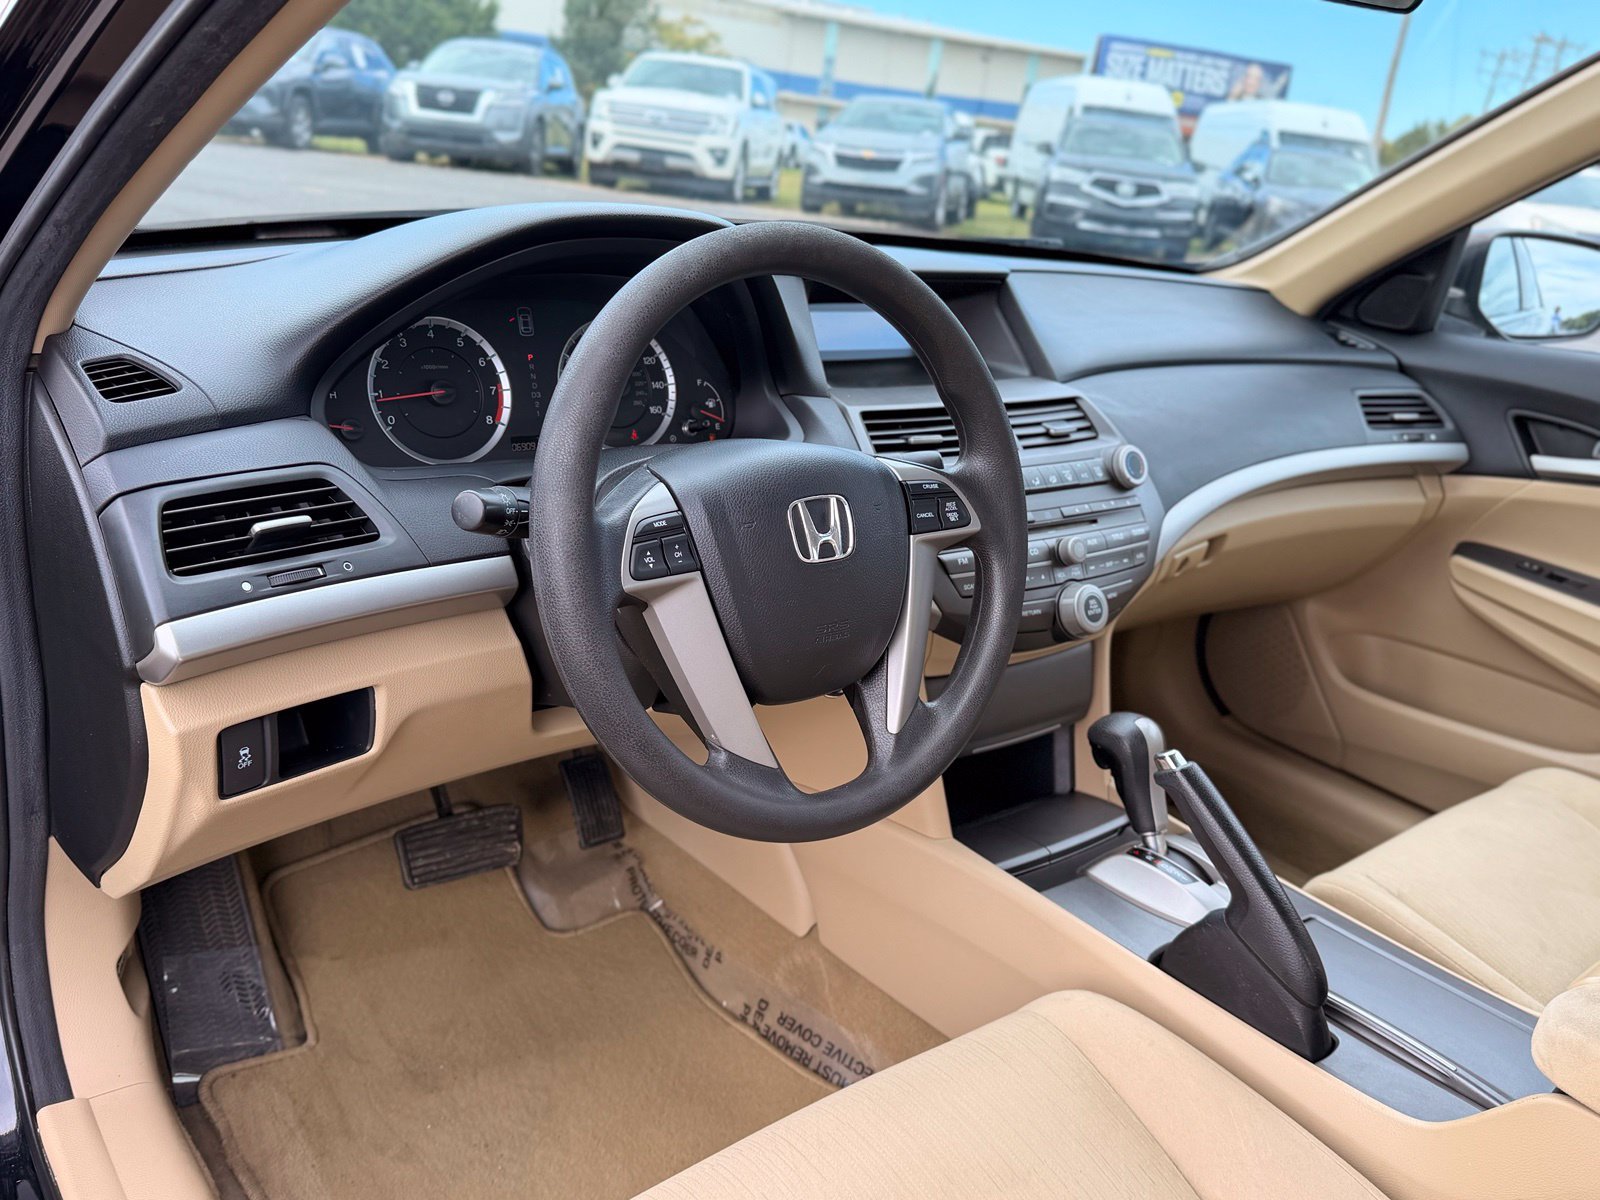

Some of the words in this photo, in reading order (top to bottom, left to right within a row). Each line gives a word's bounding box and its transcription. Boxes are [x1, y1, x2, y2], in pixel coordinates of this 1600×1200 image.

[1106, 54, 1144, 79] SIZE
[1149, 58, 1228, 96] MATTERS
[427, 329, 434, 338] 4
[399, 338, 407, 347] 3
[457, 338, 464, 347] 5
[381, 360, 390, 369] 2
[478, 357, 486, 366] 6
[643, 357, 656, 365] 120
[651, 381, 664, 389] 140
[489, 386, 497, 395] 7
[649, 406, 662, 414] 160
[387, 415, 396, 425] 0
[486, 415, 493, 425] 8
[505, 507, 516, 515] OFF
[653, 520, 668, 528] MODE
[643, 556, 656, 564] VOL
[957, 558, 969, 566] FM
[237, 759, 253, 770] OFF
[777, 1011, 823, 1049] COVER
